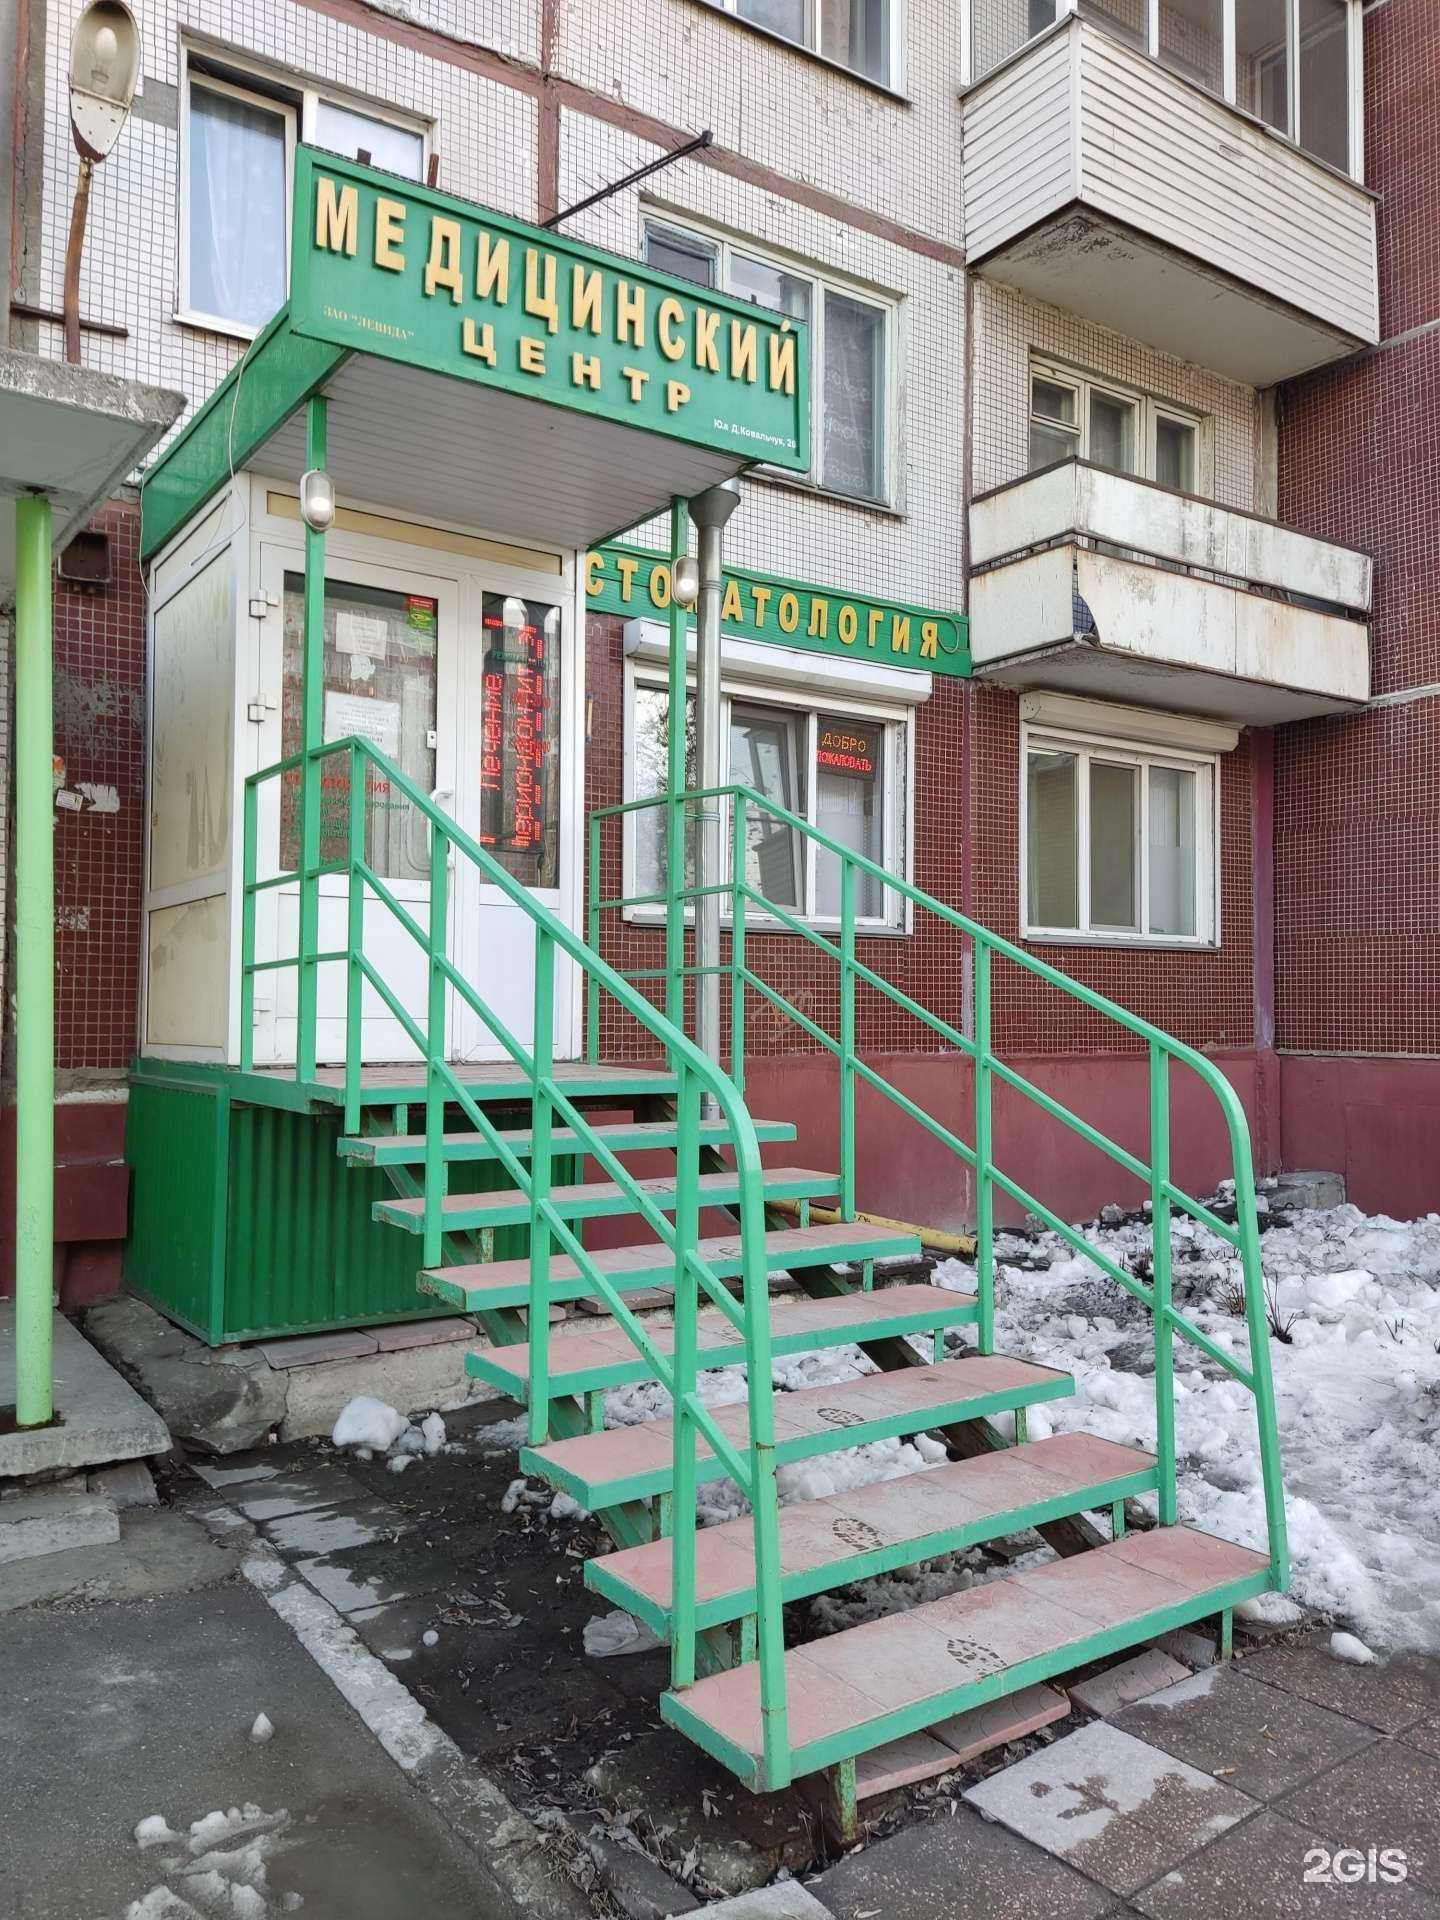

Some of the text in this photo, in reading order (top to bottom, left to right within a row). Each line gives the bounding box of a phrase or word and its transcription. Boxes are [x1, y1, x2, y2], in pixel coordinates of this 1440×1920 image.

[314, 176, 795, 396] МЕДИЦИНСКИЙ
[323, 304, 349, 321] ЗАО
[462, 318, 693, 412] ЦЕНТР
[585, 552, 938, 659] СТОАТОЛОГИЯ
[821, 731, 867, 753] ДОБРО
